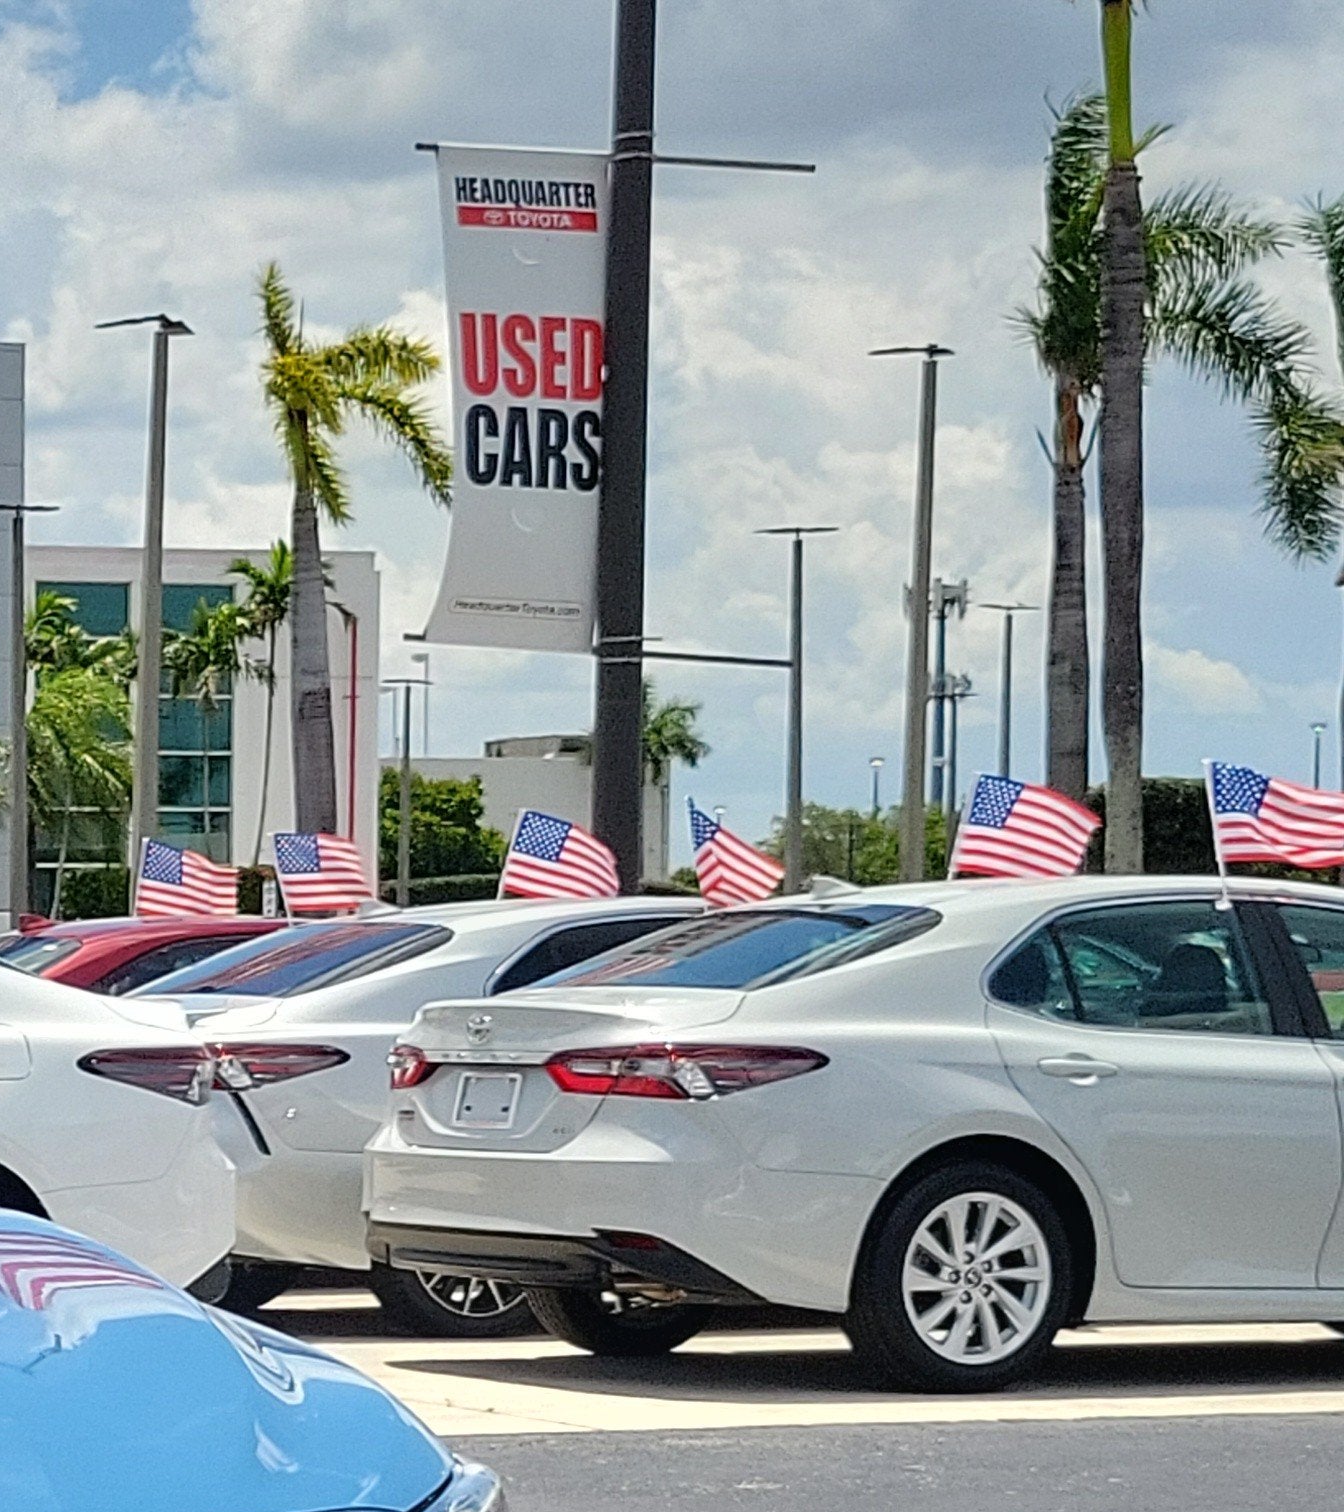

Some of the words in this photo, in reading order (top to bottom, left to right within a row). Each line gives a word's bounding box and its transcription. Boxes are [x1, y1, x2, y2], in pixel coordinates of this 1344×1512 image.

[454, 176, 597, 208] HEADQUARTER
[507, 211, 573, 228] TOYOTA
[459, 312, 604, 401] USED
[465, 404, 602, 492] CARS
